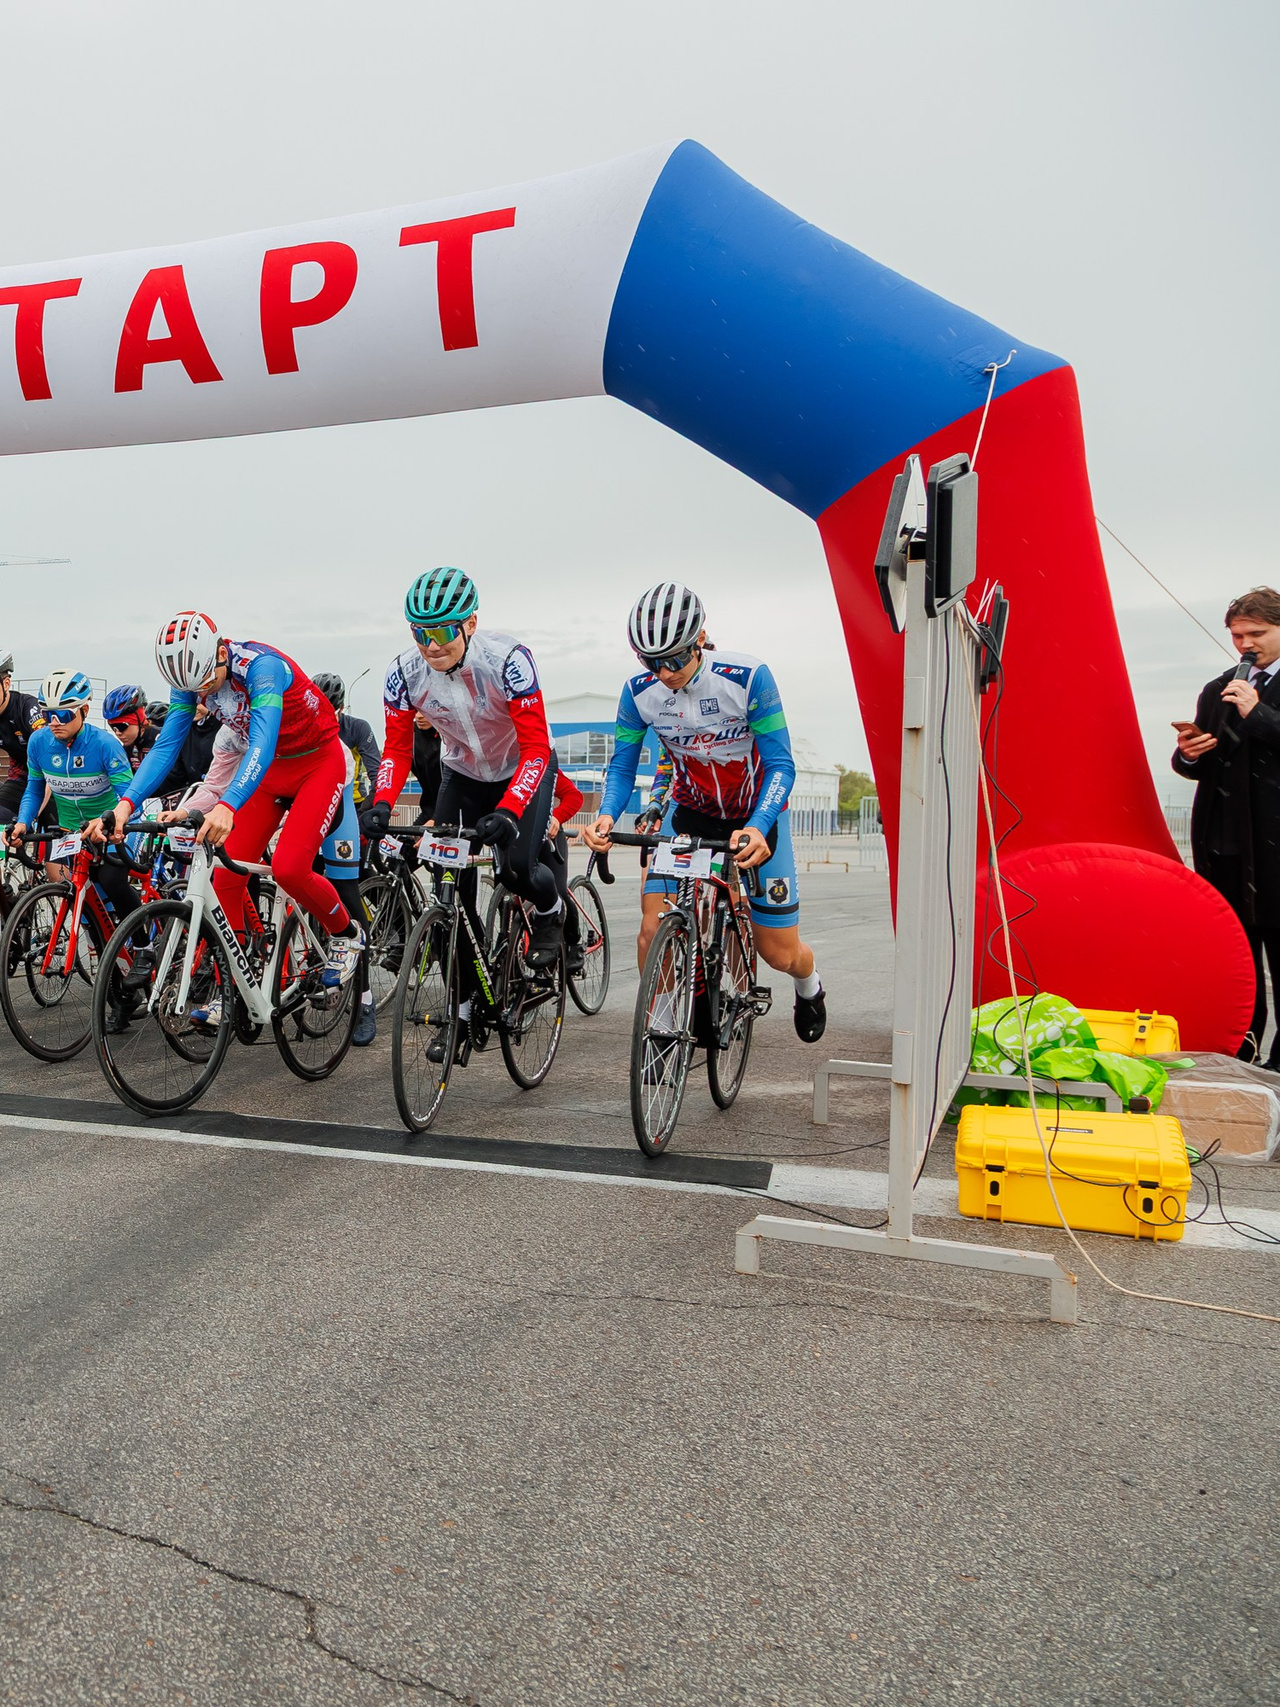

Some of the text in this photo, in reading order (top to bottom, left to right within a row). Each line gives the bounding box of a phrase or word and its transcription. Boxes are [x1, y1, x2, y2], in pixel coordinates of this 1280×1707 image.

[713, 666, 745, 675] ITERA
[510, 769, 540, 801] Русь
[319, 782, 345, 839] RUSSIA
[56, 840, 76, 855] 75
[174, 836, 197, 848] 37
[429, 842, 460, 860] 110
[673, 853, 692, 869] 5
[211, 904, 257, 989] Bianchi
[473, 959, 495, 1006] MERIDA
